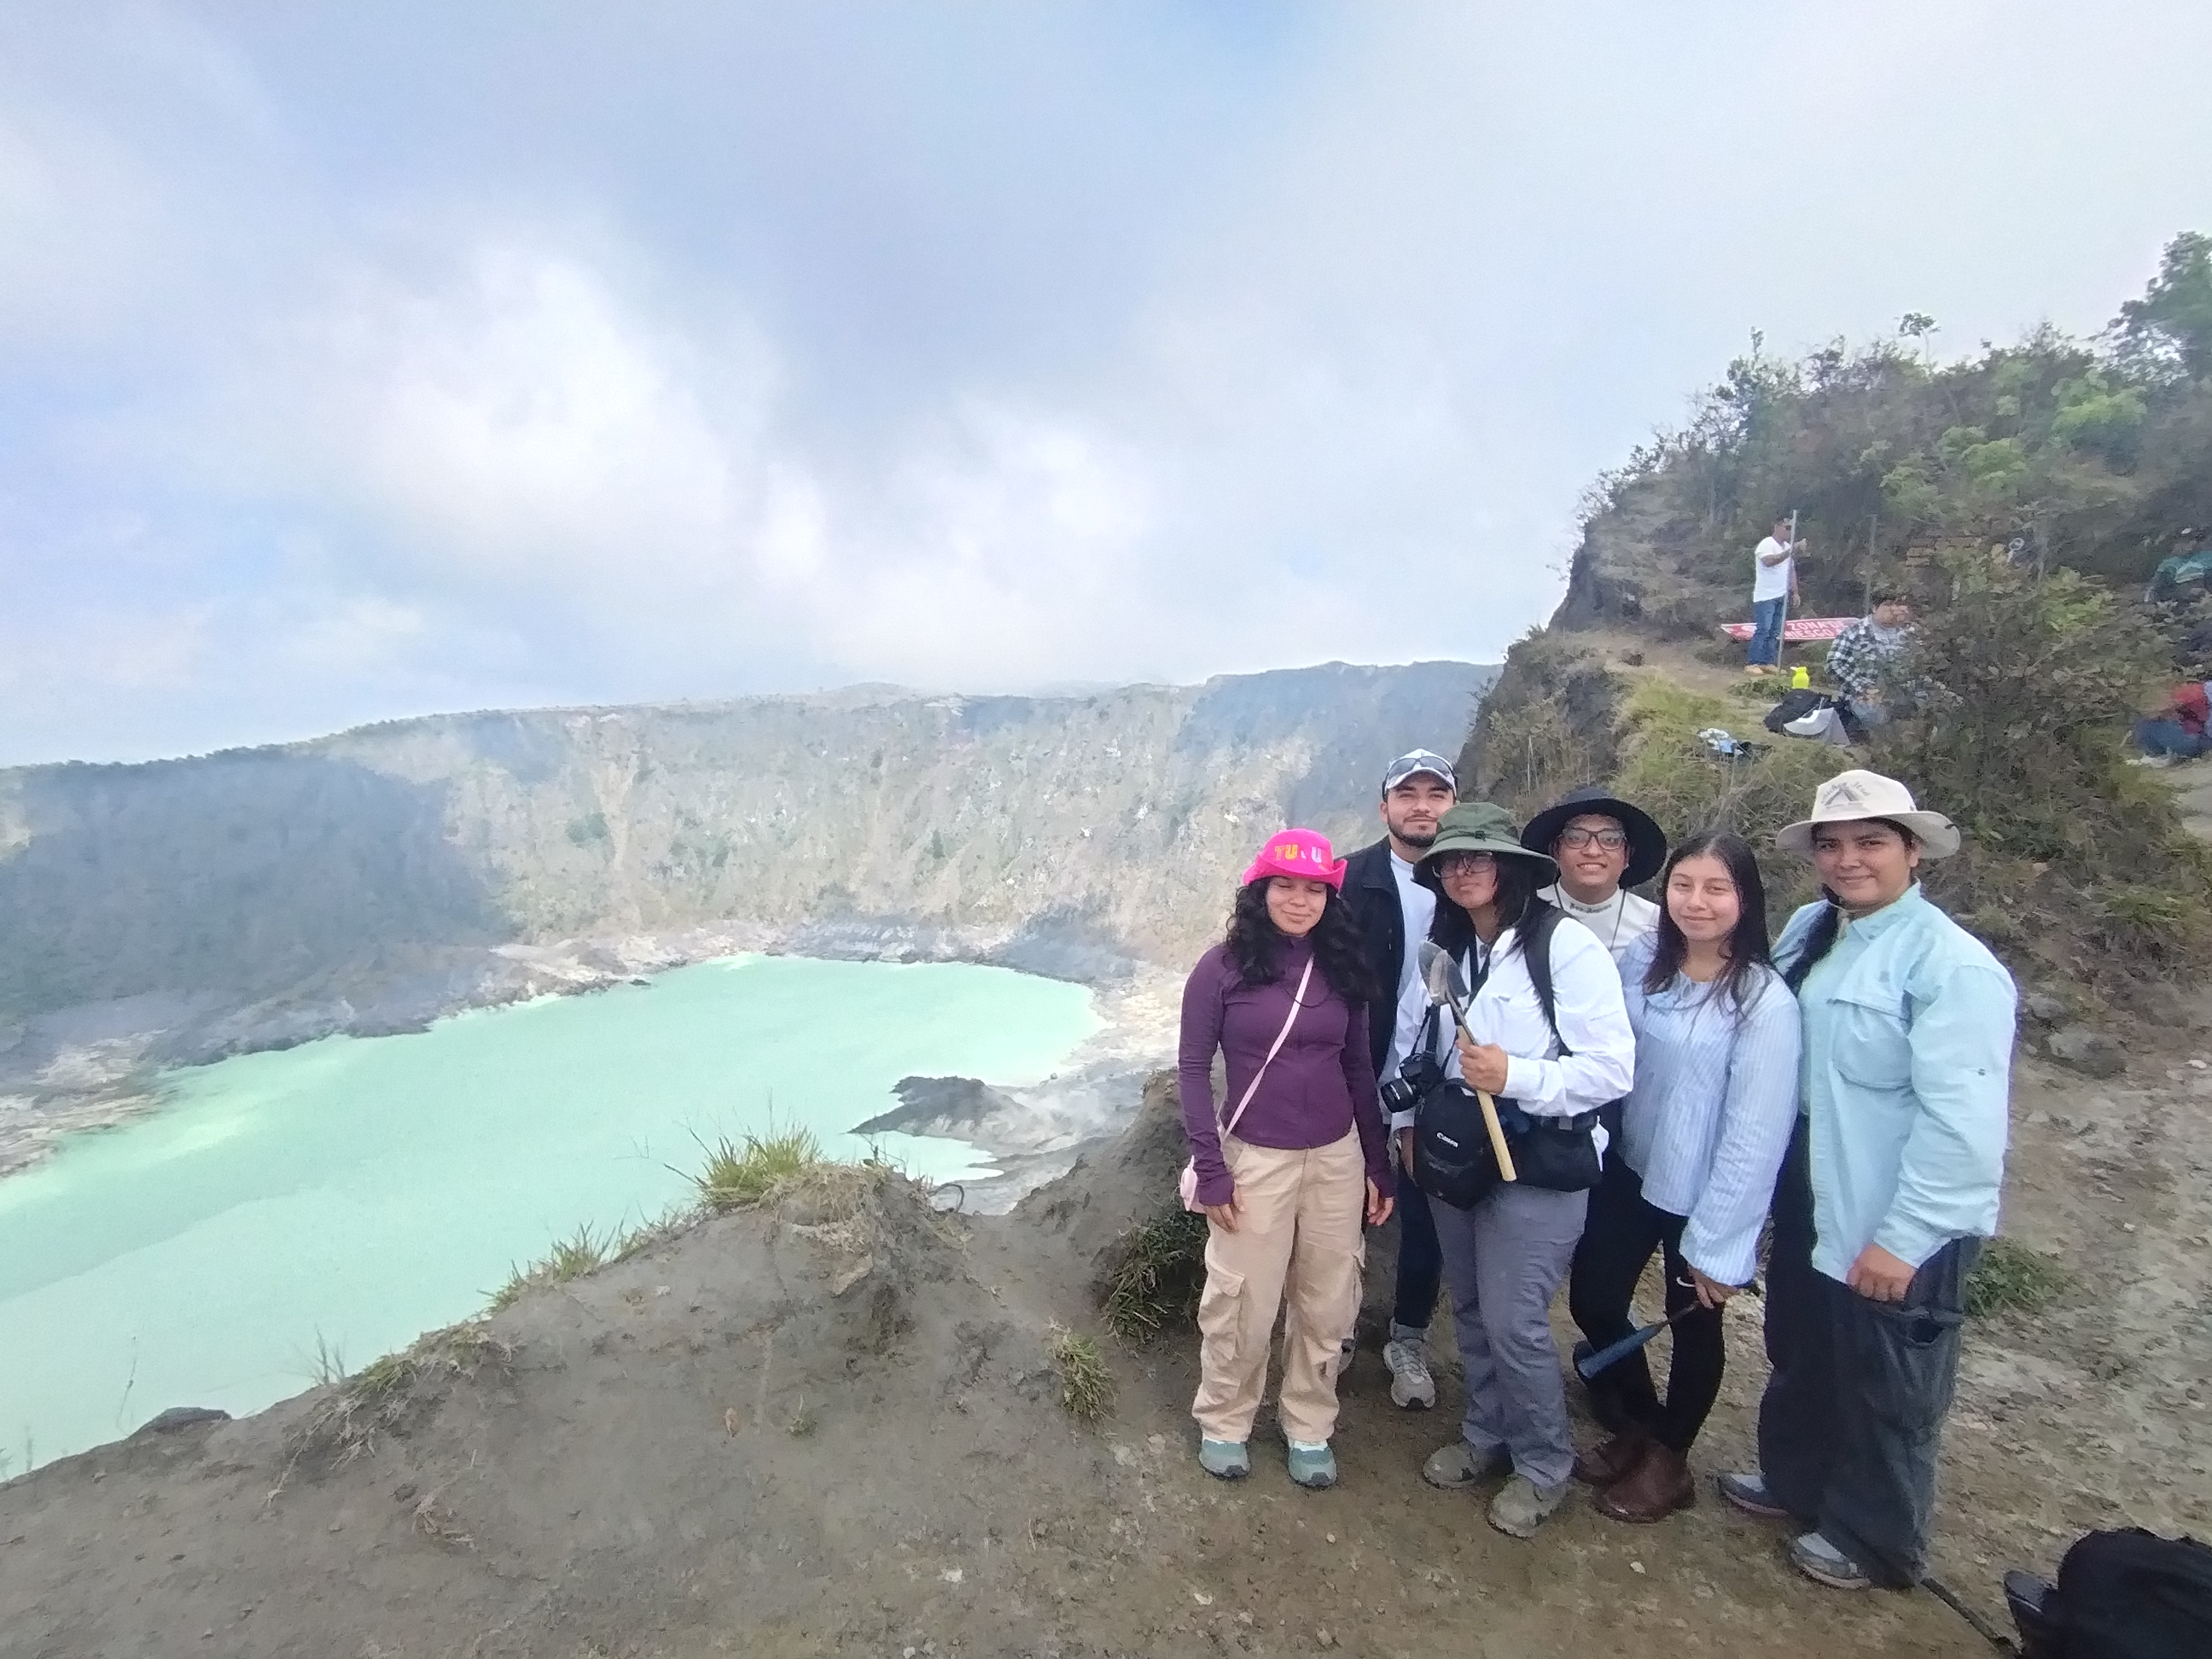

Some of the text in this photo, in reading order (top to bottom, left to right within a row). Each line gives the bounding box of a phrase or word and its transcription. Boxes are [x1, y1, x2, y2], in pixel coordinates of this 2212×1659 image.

[1787, 621, 1827, 631] ZONA
[1784, 629, 1835, 637] RIESGO
[1437, 1132, 1458, 1148] Canon
